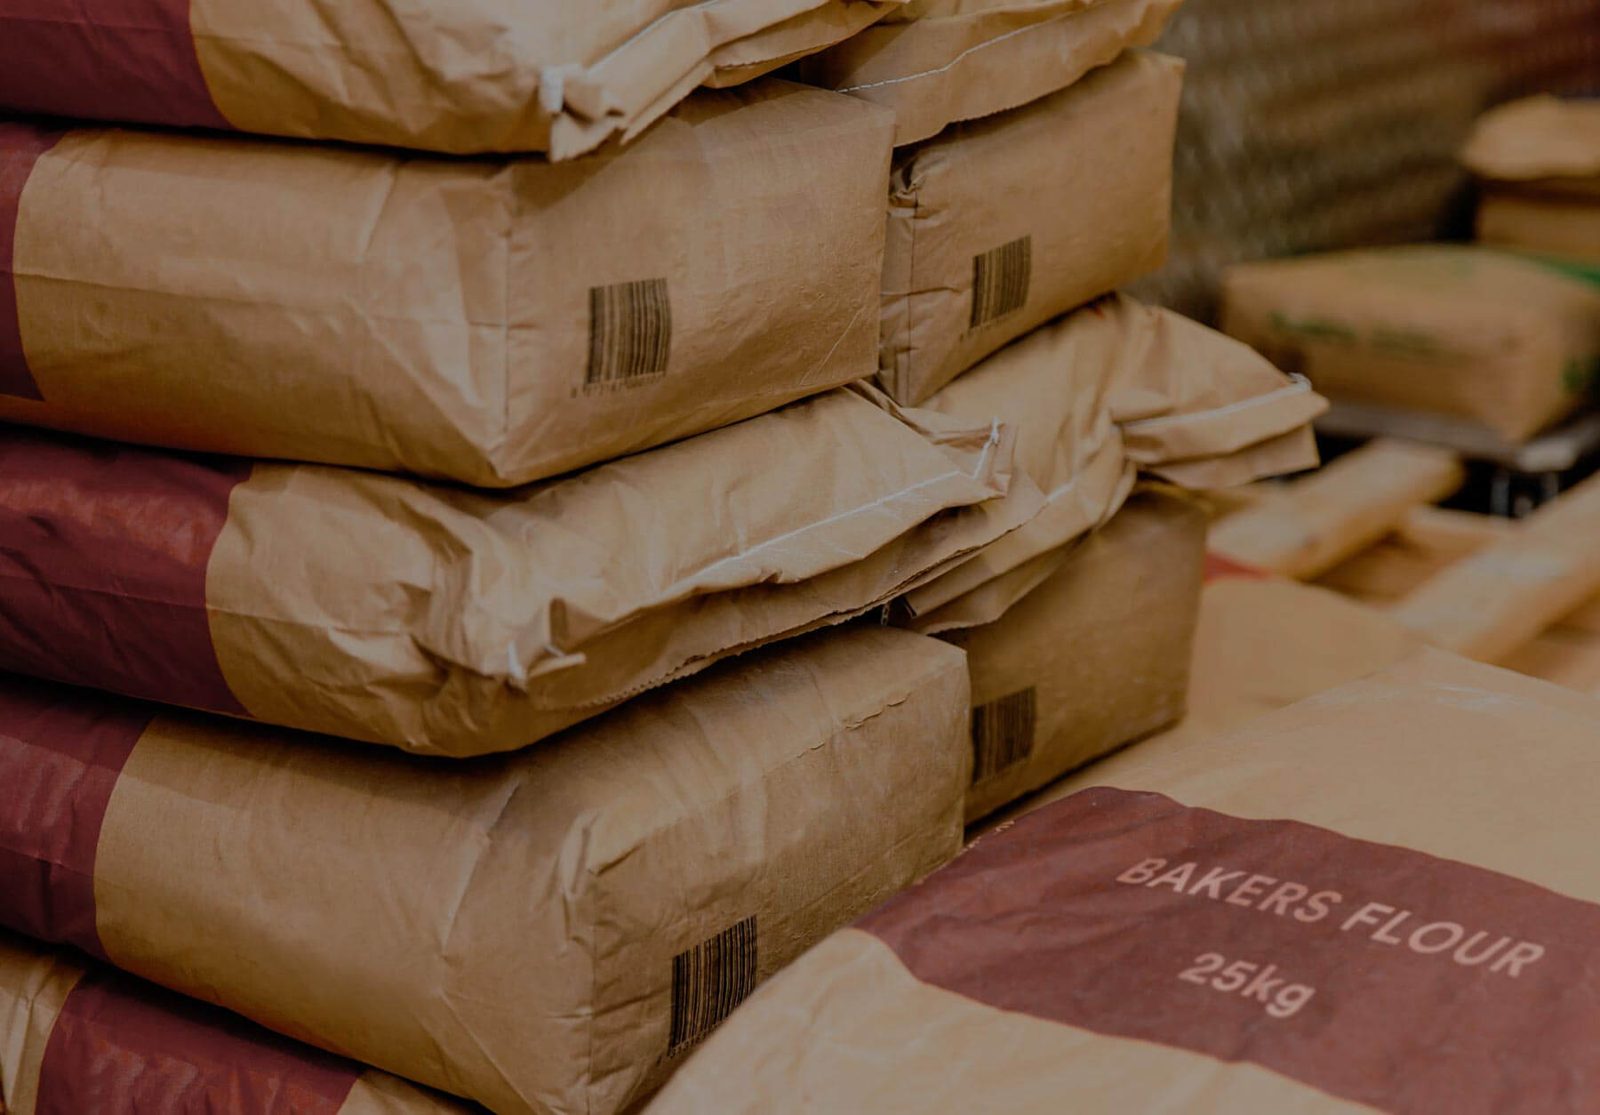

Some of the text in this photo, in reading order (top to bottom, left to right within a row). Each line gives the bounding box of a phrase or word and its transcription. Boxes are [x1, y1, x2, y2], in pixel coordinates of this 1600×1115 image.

[1116, 858, 1545, 978] BAKERS FLOUR
[1178, 953, 1316, 1017] 25kg
